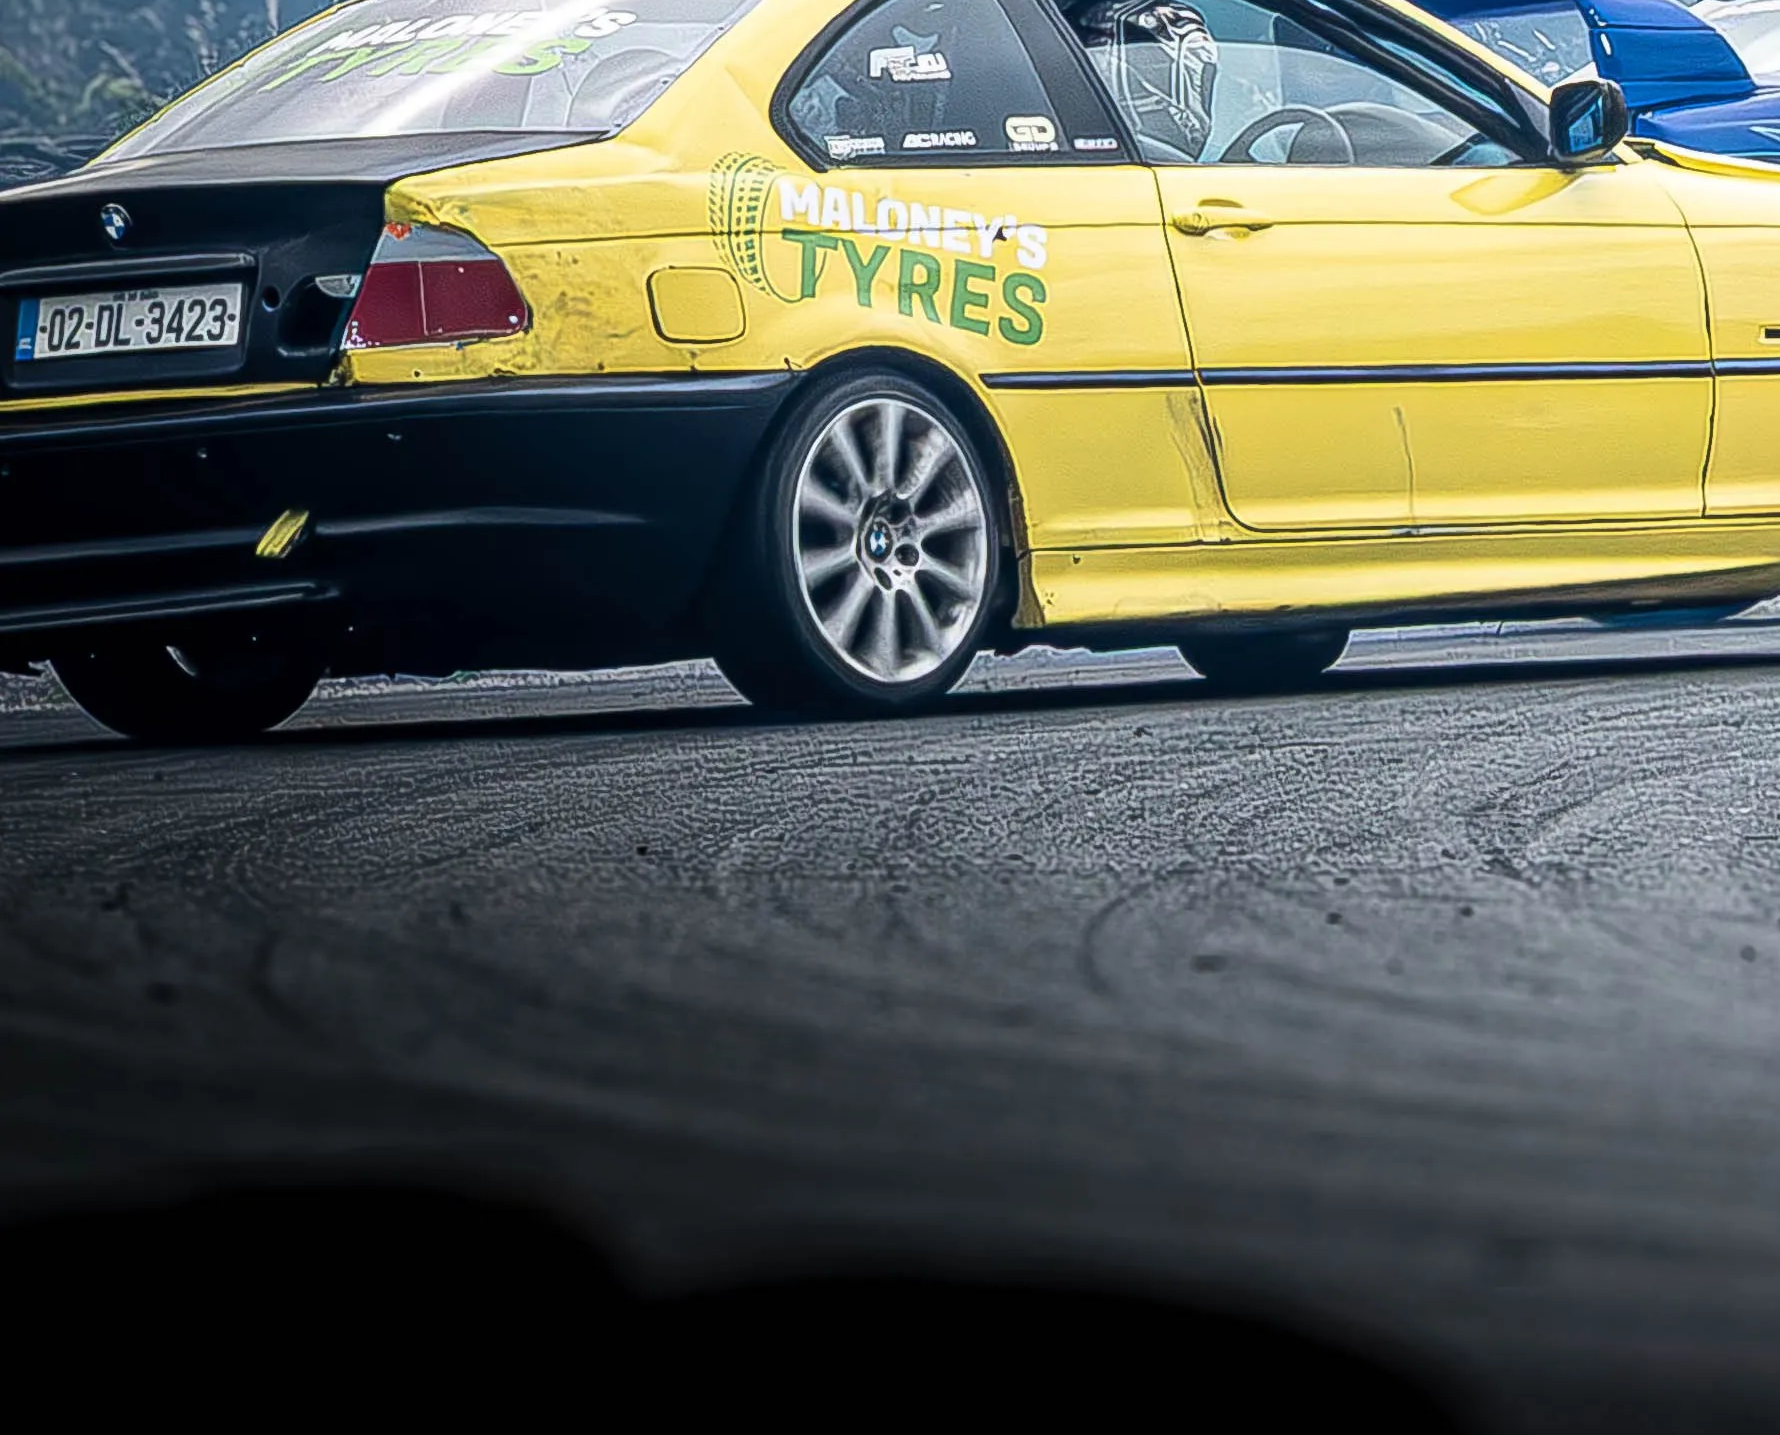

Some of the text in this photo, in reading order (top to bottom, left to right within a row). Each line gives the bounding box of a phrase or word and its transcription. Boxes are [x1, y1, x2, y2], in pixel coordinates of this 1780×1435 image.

[776, 178, 1047, 269] MALONEY'S
[47, 298, 227, 352] 02-DL-3423
[781, 228, 1047, 345] TYRES
